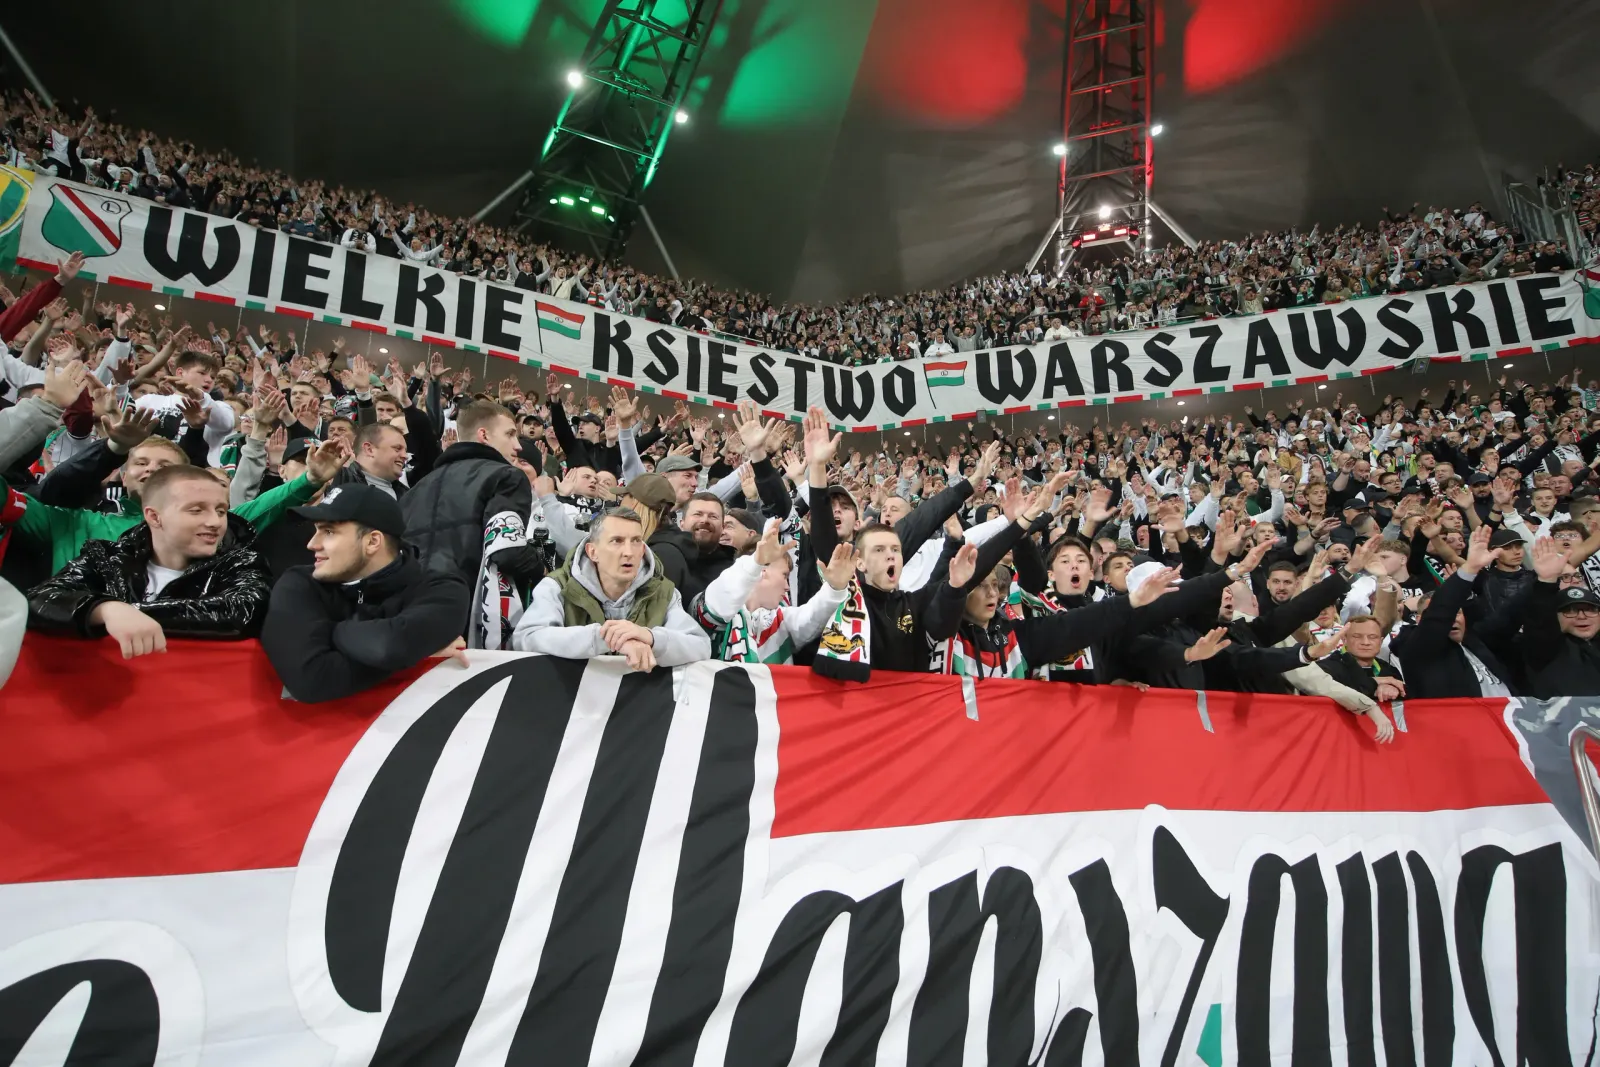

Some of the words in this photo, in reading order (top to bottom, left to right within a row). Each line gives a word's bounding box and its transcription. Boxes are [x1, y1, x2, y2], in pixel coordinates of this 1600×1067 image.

[143, 205, 525, 352] WIELKIE
[592, 312, 917, 423] KSIĘSTWO
[974, 275, 1576, 405] WARSZAWSKIE
